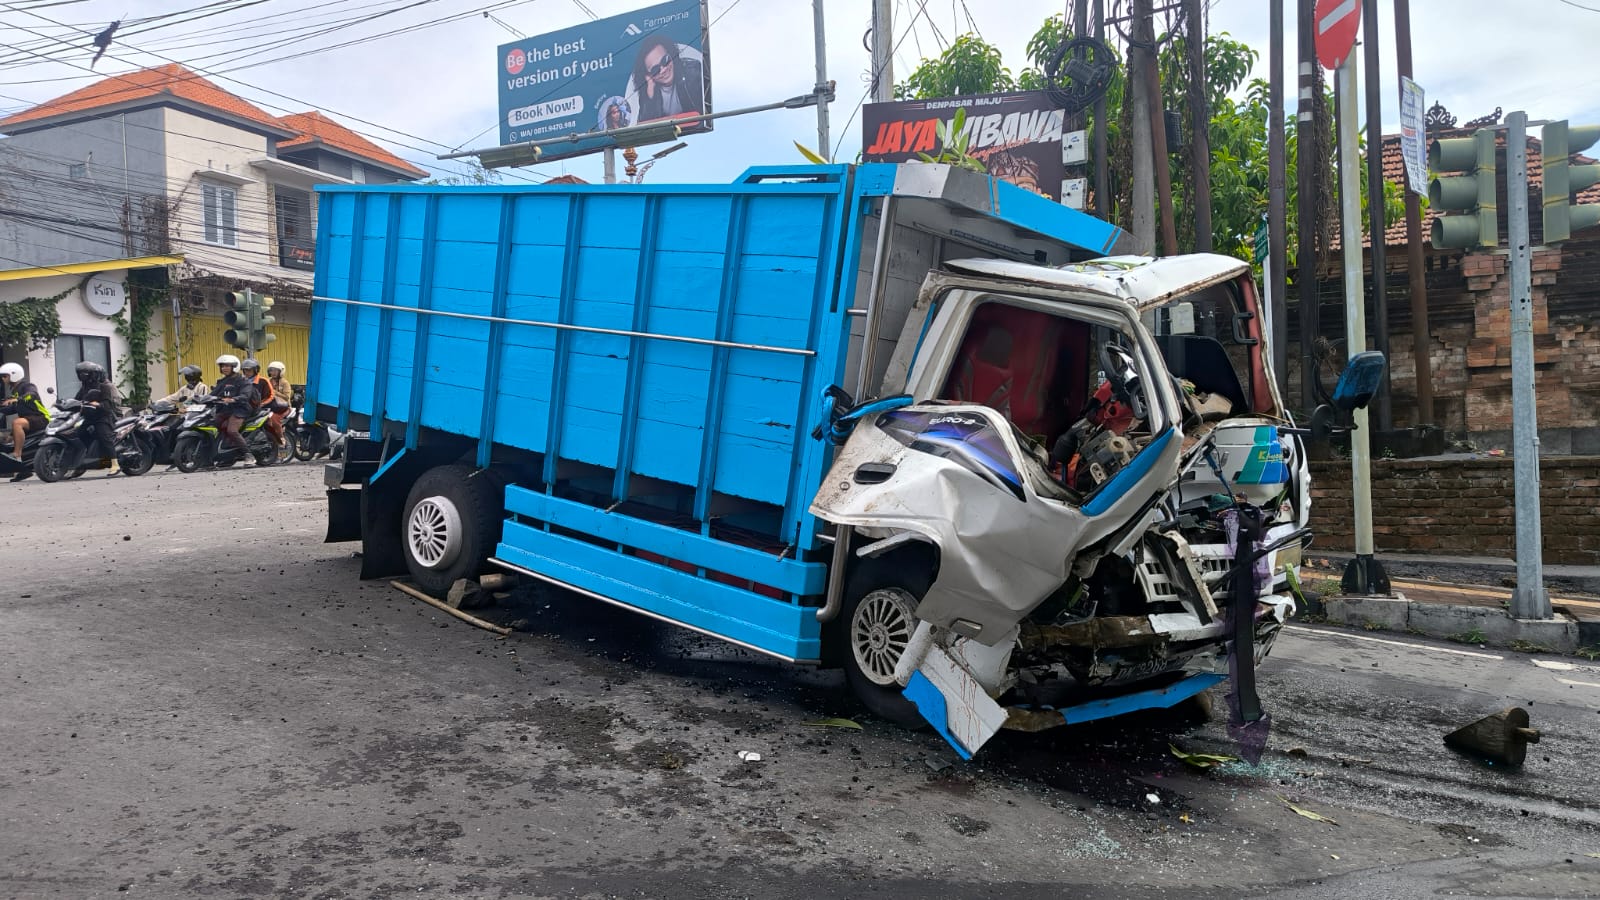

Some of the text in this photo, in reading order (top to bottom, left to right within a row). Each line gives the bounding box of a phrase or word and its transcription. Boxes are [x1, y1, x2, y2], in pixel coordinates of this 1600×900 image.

[507, 37, 586, 69] Be the best
[507, 52, 613, 90] version of you!
[515, 107, 543, 121] Book
[546, 98, 576, 115] Now!
[926, 96, 1002, 110] DENPASAR MAJU
[866, 109, 1066, 155] JAYA WIBAWA
